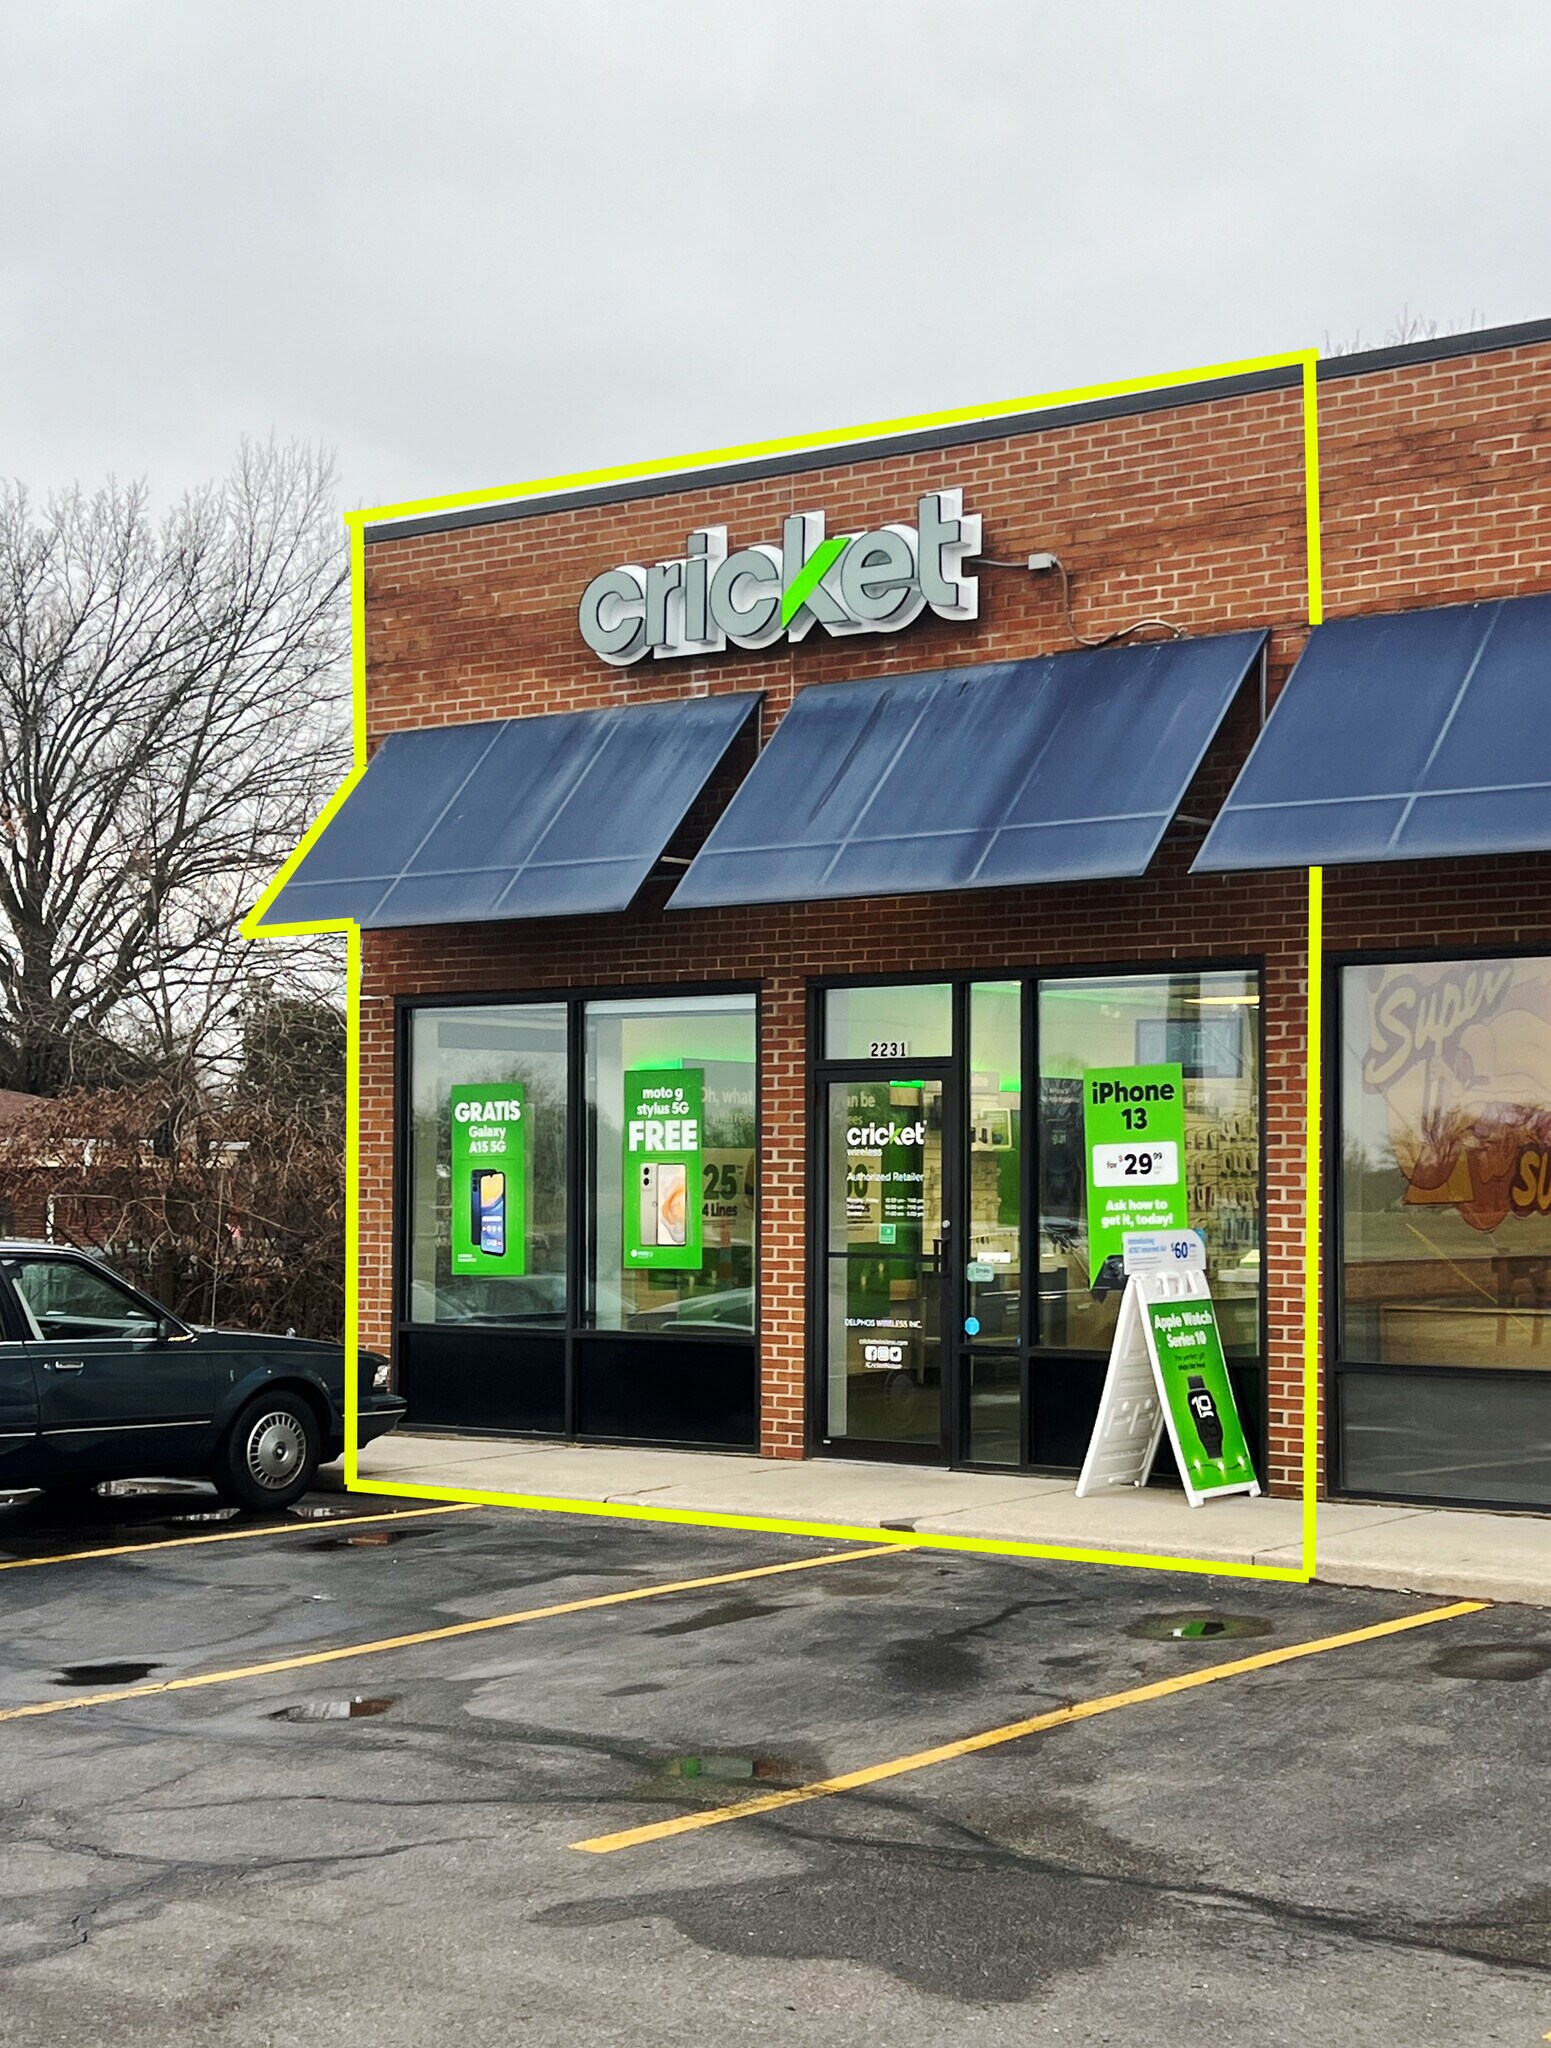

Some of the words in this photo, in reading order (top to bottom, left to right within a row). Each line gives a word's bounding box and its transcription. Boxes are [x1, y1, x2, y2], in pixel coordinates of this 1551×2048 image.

[578, 488, 982, 666] cricket
[1364, 965, 1511, 1084] Super
[871, 1043, 906, 1057] 2231
[642, 1087, 673, 1099] moto
[674, 1088, 683, 1101] g
[861, 1092, 875, 1107] be
[1092, 1081, 1174, 1104] iPhone
[455, 1100, 521, 1122] GRATIS
[637, 1102, 670, 1118] stylus
[672, 1102, 689, 1114] 5G
[1122, 1108, 1148, 1130] 13
[469, 1125, 506, 1140] Galaxy
[629, 1120, 698, 1151] FREE
[847, 1122, 924, 1145] cricket
[469, 1141, 489, 1153] A15
[490, 1140, 506, 1153] 5G
[846, 1147, 882, 1156] wireless
[703, 1163, 737, 1200] 25
[847, 1171, 892, 1181] Authorized
[893, 1171, 924, 1181] Retailer
[711, 1203, 737, 1217] Lines
[1105, 1200, 1126, 1211] Ask
[1128, 1199, 1153, 1210] how
[1155, 1199, 1168, 1210] to
[1101, 1215, 1121, 1228] get
[1122, 1214, 1134, 1227] it,
[1136, 1213, 1173, 1227] today!
[844, 1318, 875, 1327] DELPHOS
[876, 1319, 908, 1328] WIRELESS
[909, 1320, 922, 1328] INC.
[1155, 1313, 1182, 1332] Apple
[1182, 1310, 1213, 1326] Watch
[1167, 1331, 1195, 1348] Series
[1195, 1330, 1207, 1345] 10
